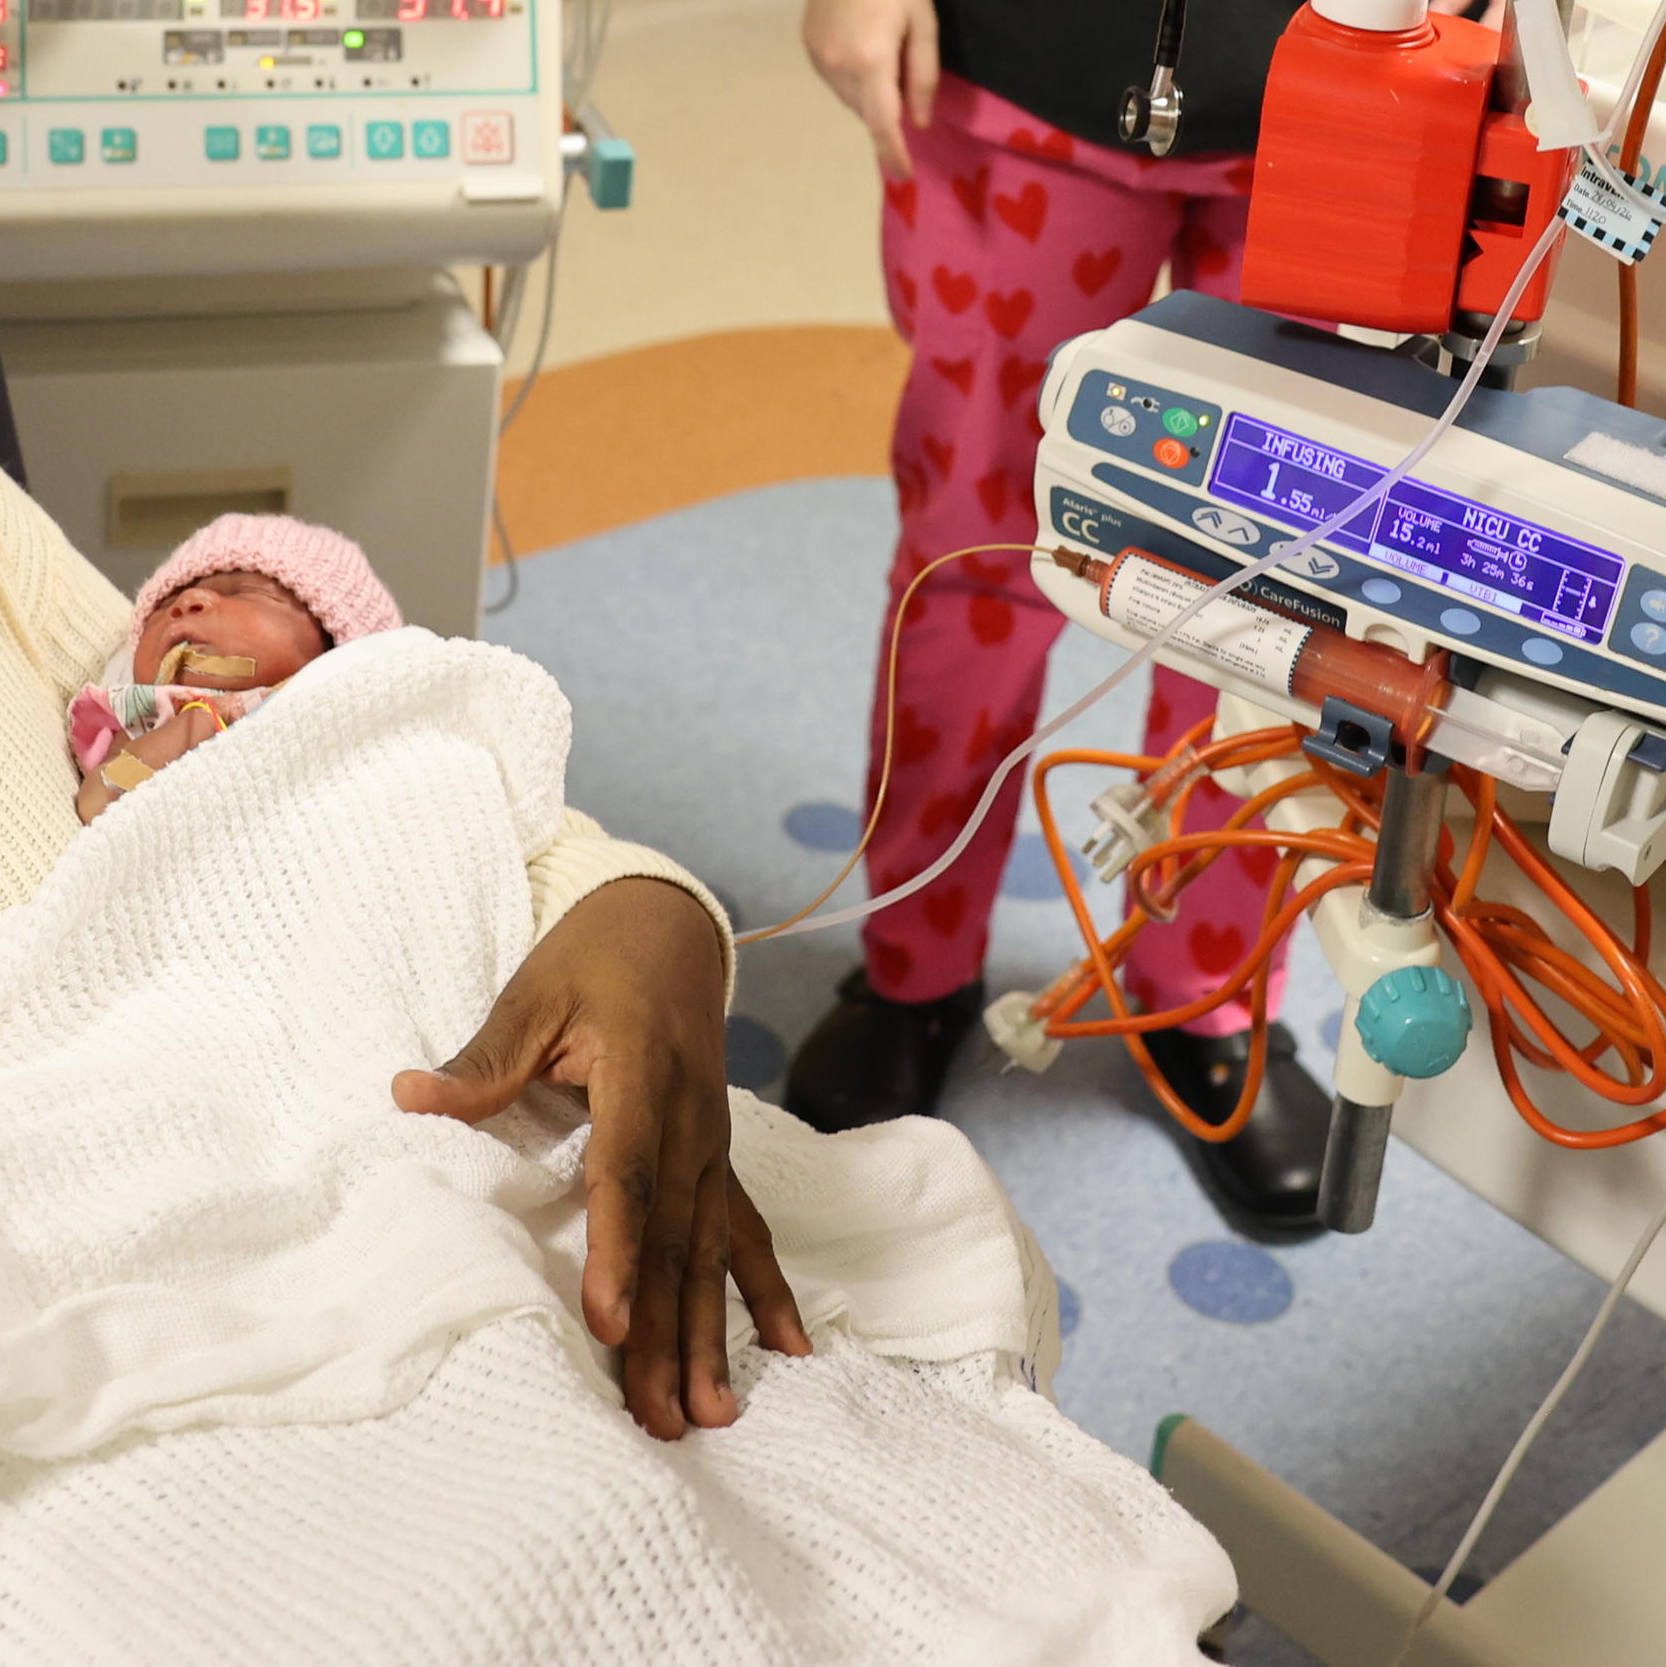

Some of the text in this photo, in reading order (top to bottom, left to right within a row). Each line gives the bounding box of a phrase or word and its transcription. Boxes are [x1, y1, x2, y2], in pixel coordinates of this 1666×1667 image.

[1262, 431, 1347, 480] INFUSING
[1062, 511, 1100, 544] CC
[1101, 513, 1122, 528] plus
[1398, 507, 1443, 534] VOLUME
[1463, 507, 1543, 553] NICU CC
[1384, 550, 1429, 576] VOLUME
[1461, 552, 1535, 591] 3h 25m 36s
[1260, 585, 1341, 628] CareFusion
[1469, 583, 1499, 603] VTBI
